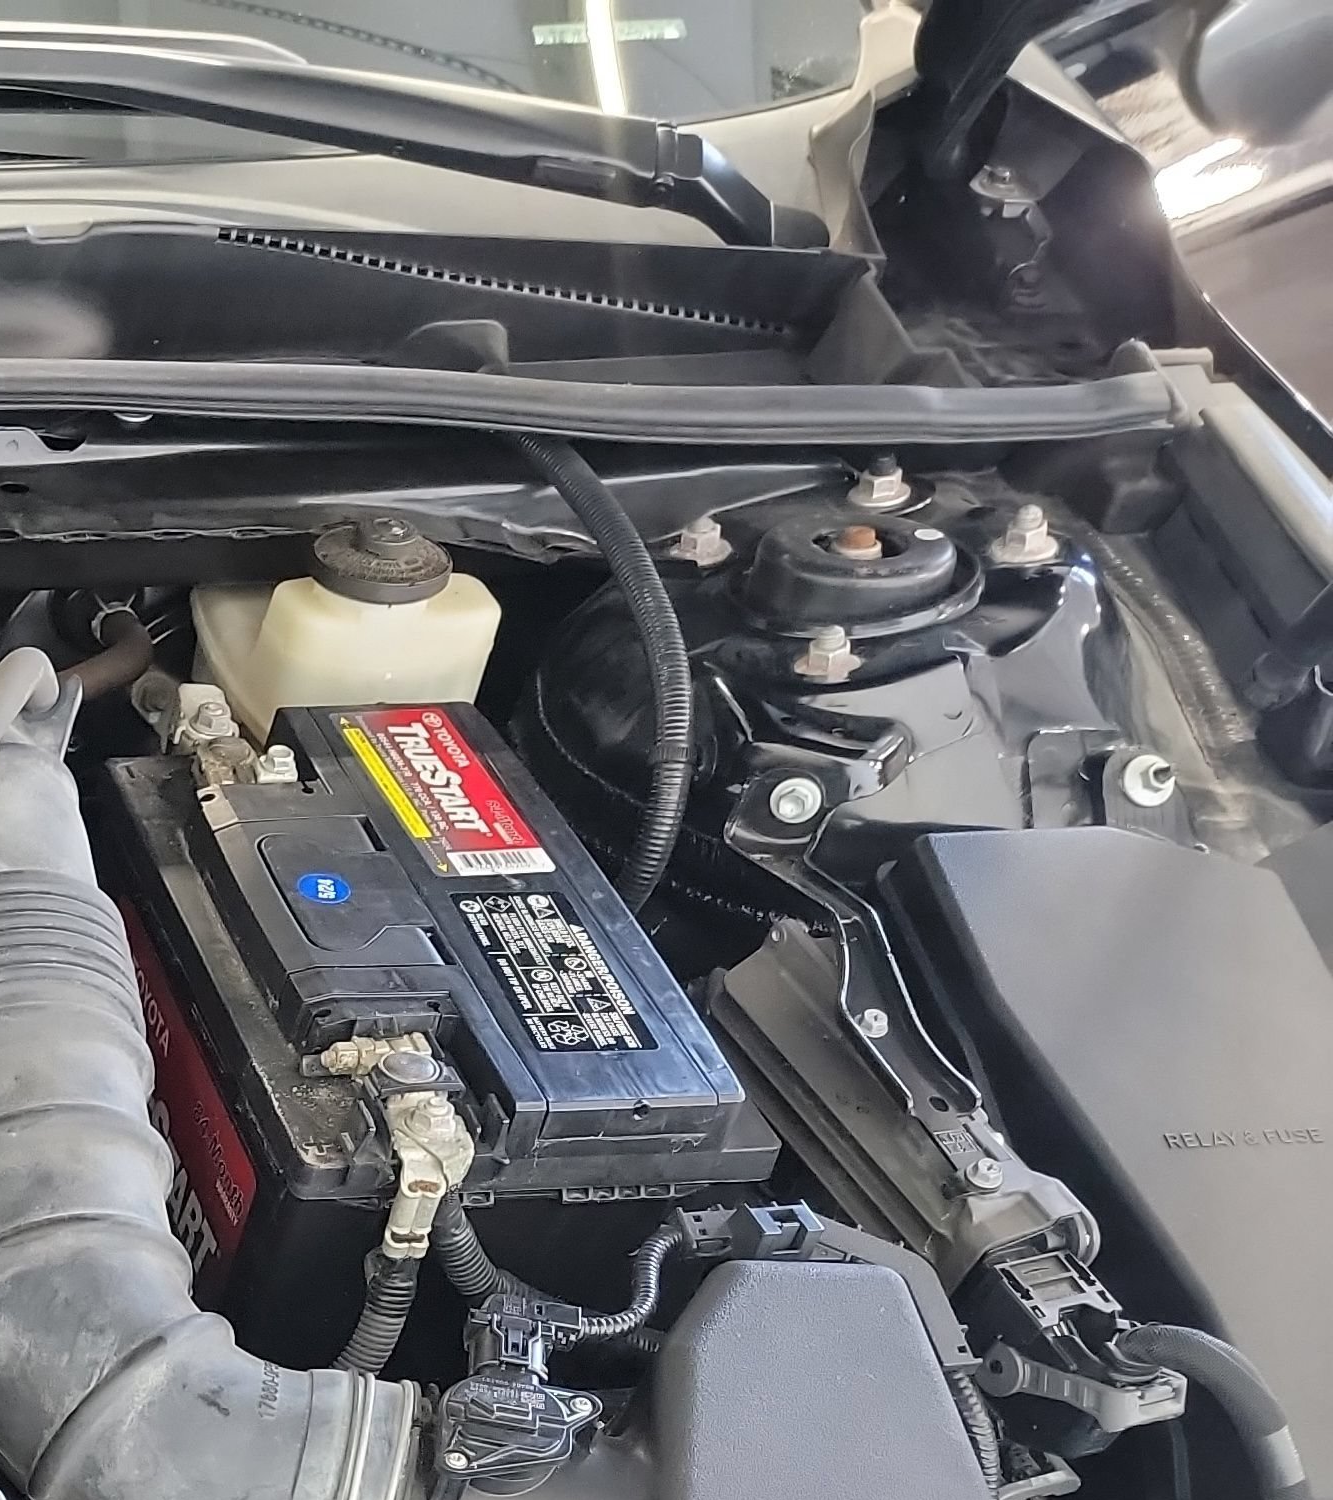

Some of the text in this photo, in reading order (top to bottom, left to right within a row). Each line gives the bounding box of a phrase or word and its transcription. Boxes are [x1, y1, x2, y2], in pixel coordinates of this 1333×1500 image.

[434, 728, 470, 768] TOYOTA
[576, 932, 635, 1015] DANGER/POISON
[1164, 1127, 1324, 1150] RELAY & FUSE
